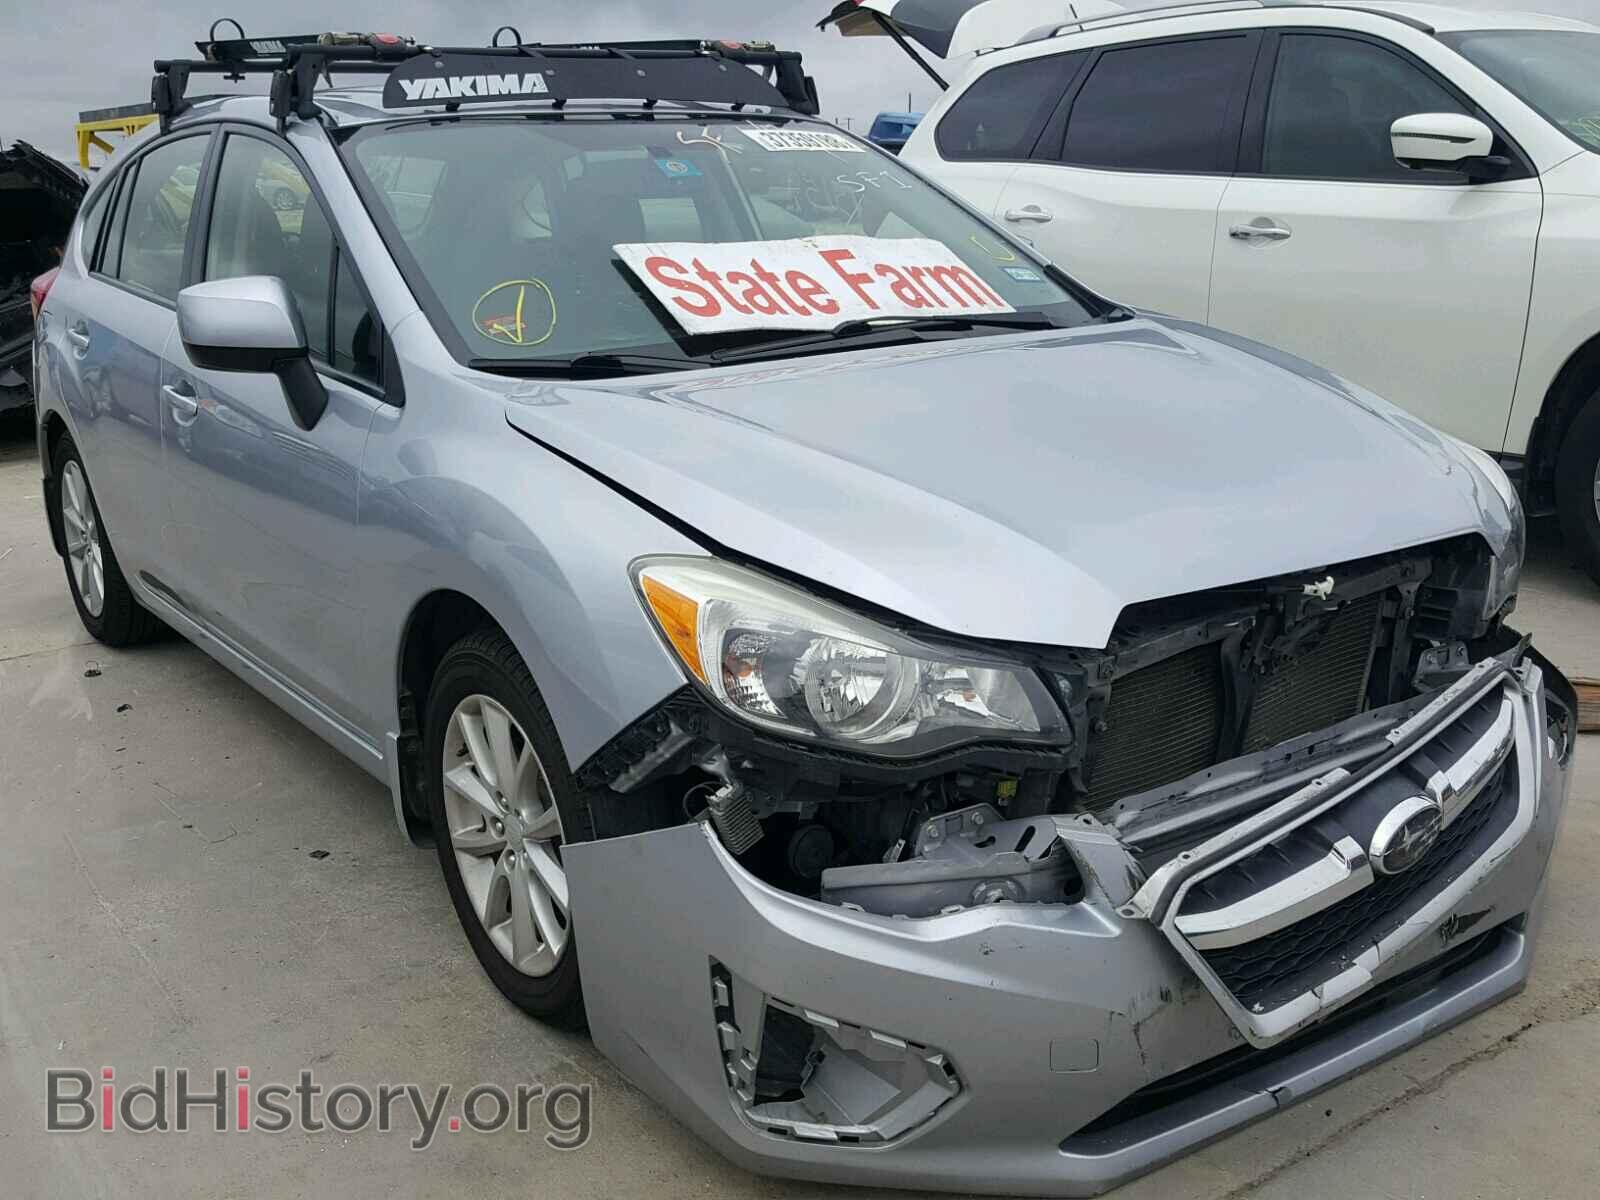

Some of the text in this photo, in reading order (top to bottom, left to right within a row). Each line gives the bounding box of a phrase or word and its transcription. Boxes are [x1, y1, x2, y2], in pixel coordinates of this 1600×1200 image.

[398, 73, 549, 100] YAKIMA
[645, 249, 1005, 317] State Farm
